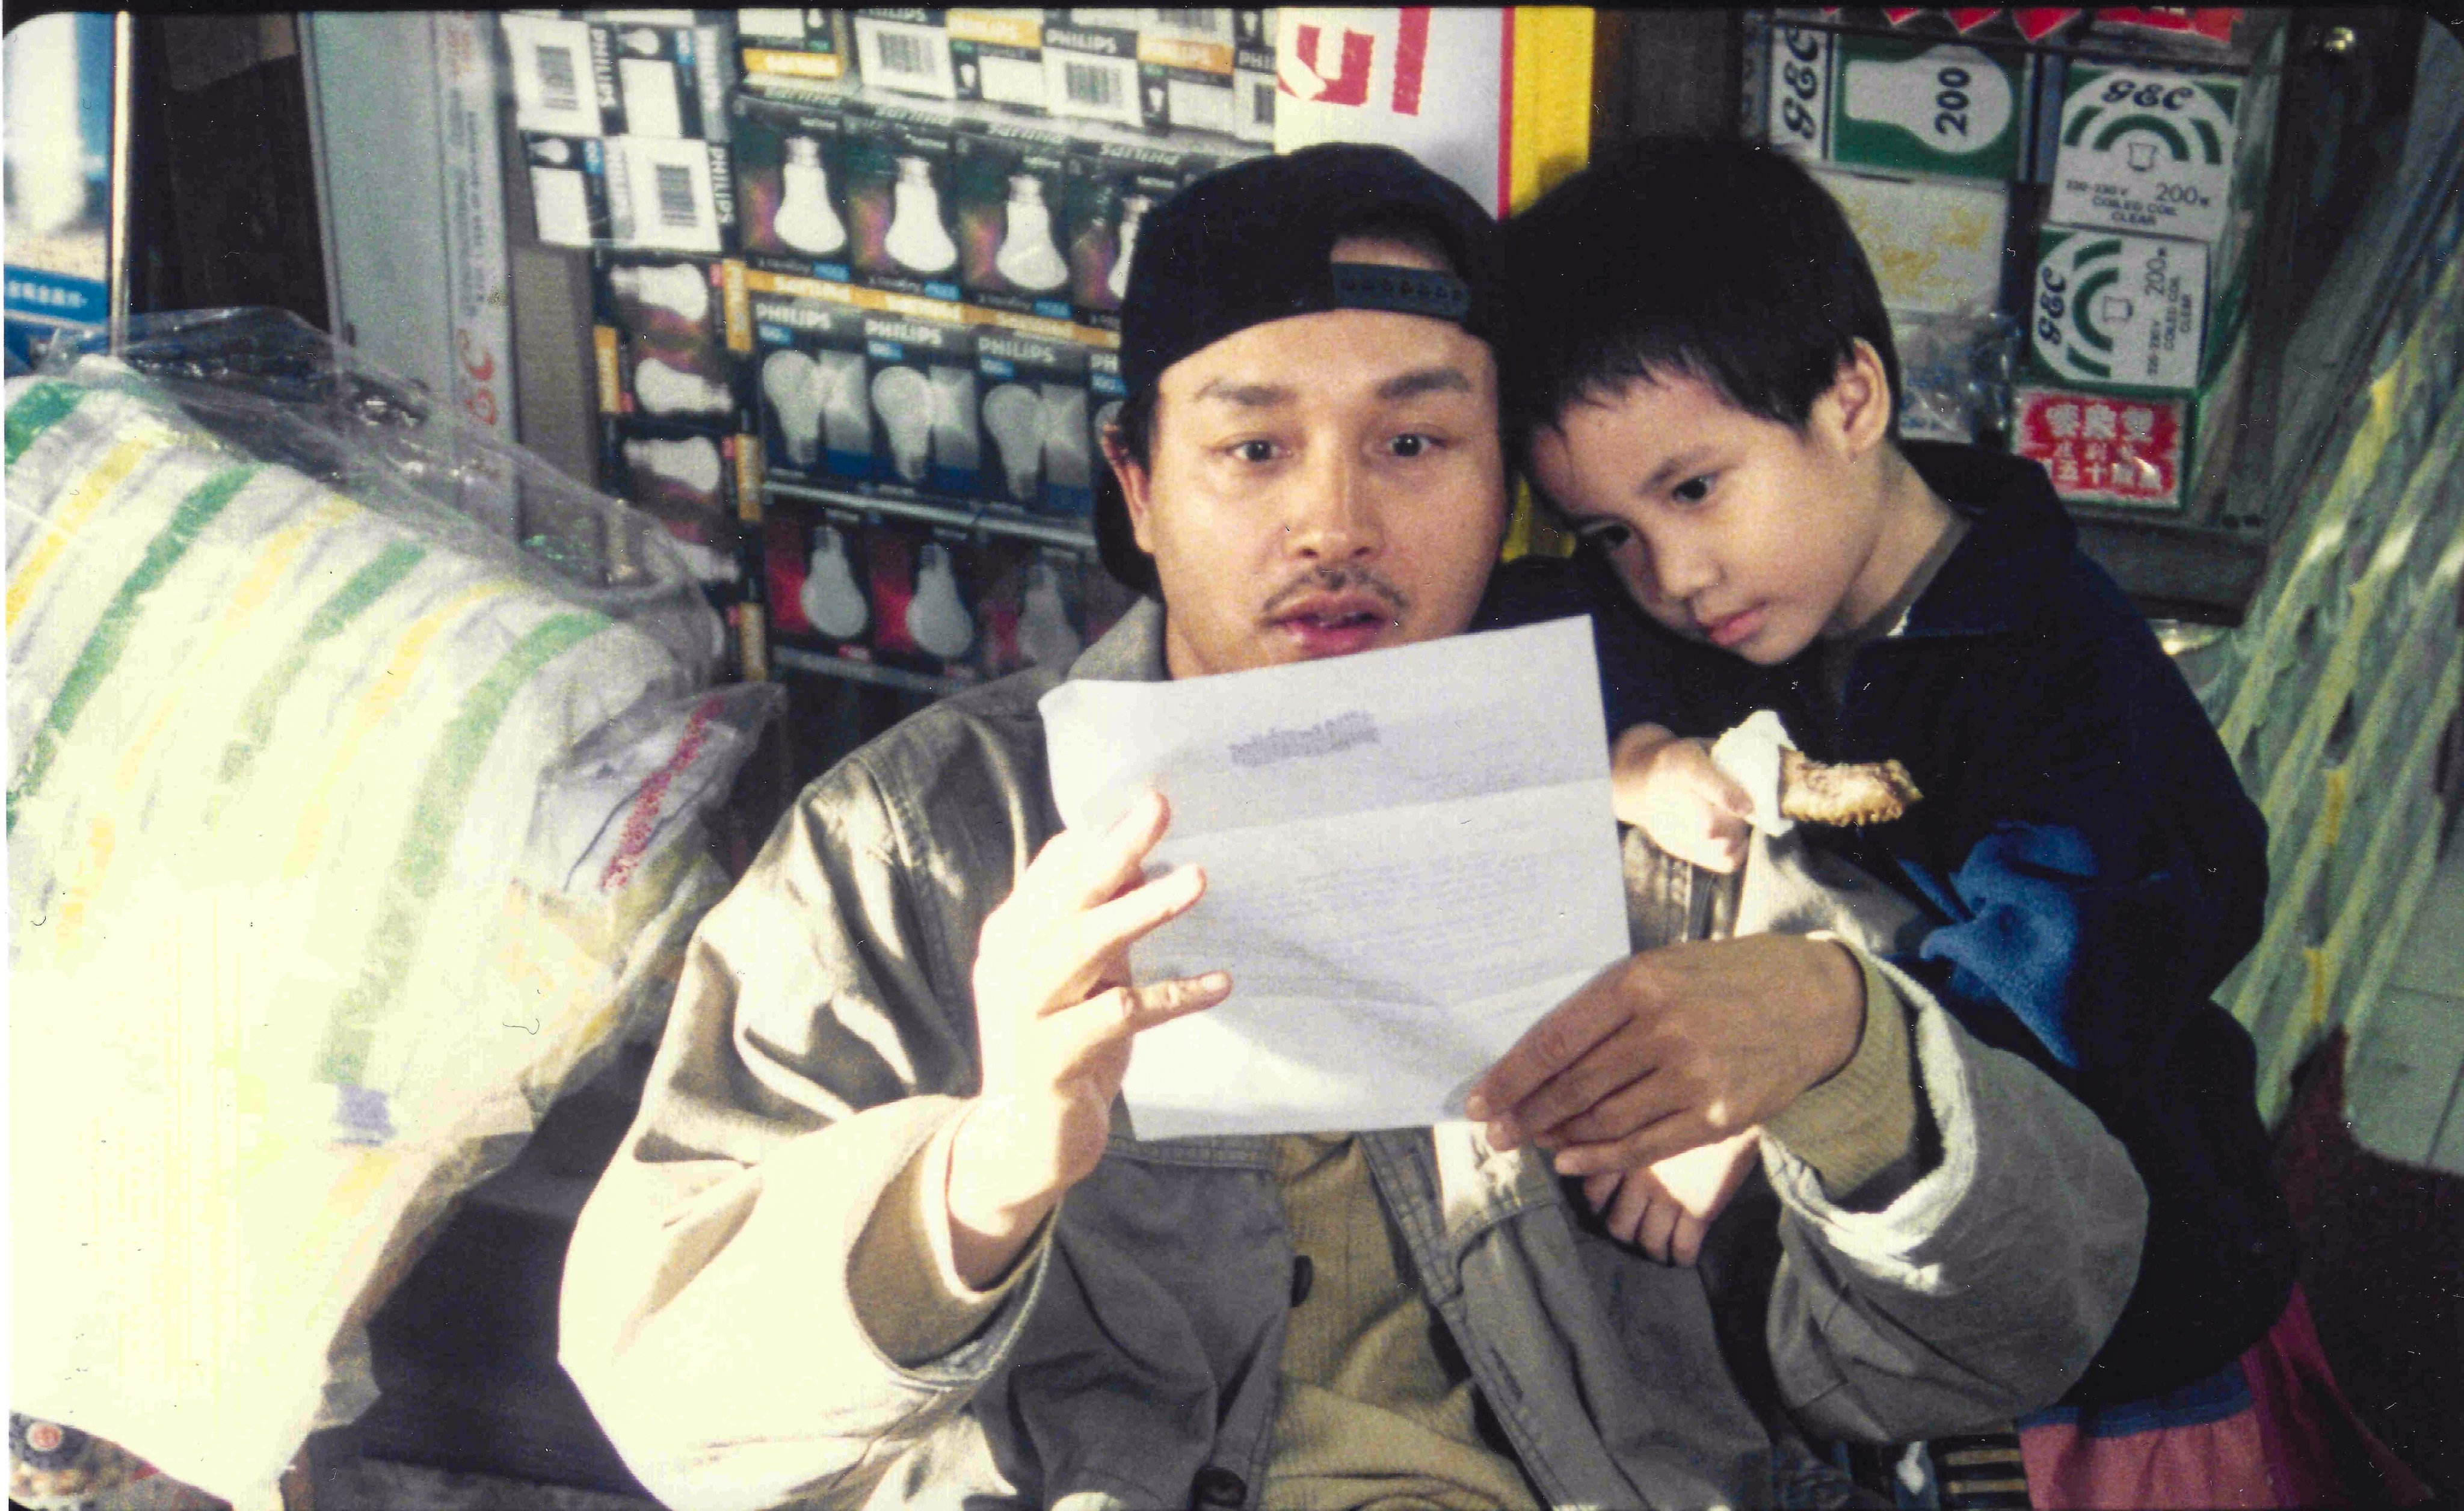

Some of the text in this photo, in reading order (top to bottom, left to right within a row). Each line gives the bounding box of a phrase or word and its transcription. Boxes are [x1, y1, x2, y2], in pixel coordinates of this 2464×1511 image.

[1046, 29, 1117, 54] PHILIPS
[590, 29, 615, 107] PHILIPS
[1935, 67, 1972, 136] 200
[2101, 79, 2194, 111] GEC
[707, 147, 735, 226] PHILIPS
[2111, 211, 2157, 226] CLEAR
[756, 303, 830, 330] PHILIPS
[2039, 266, 2066, 346] GEC
[2179, 292, 2192, 333] CLEAR
[865, 318, 942, 348] PHILIPS
[979, 336, 1056, 364] PHILIPS
